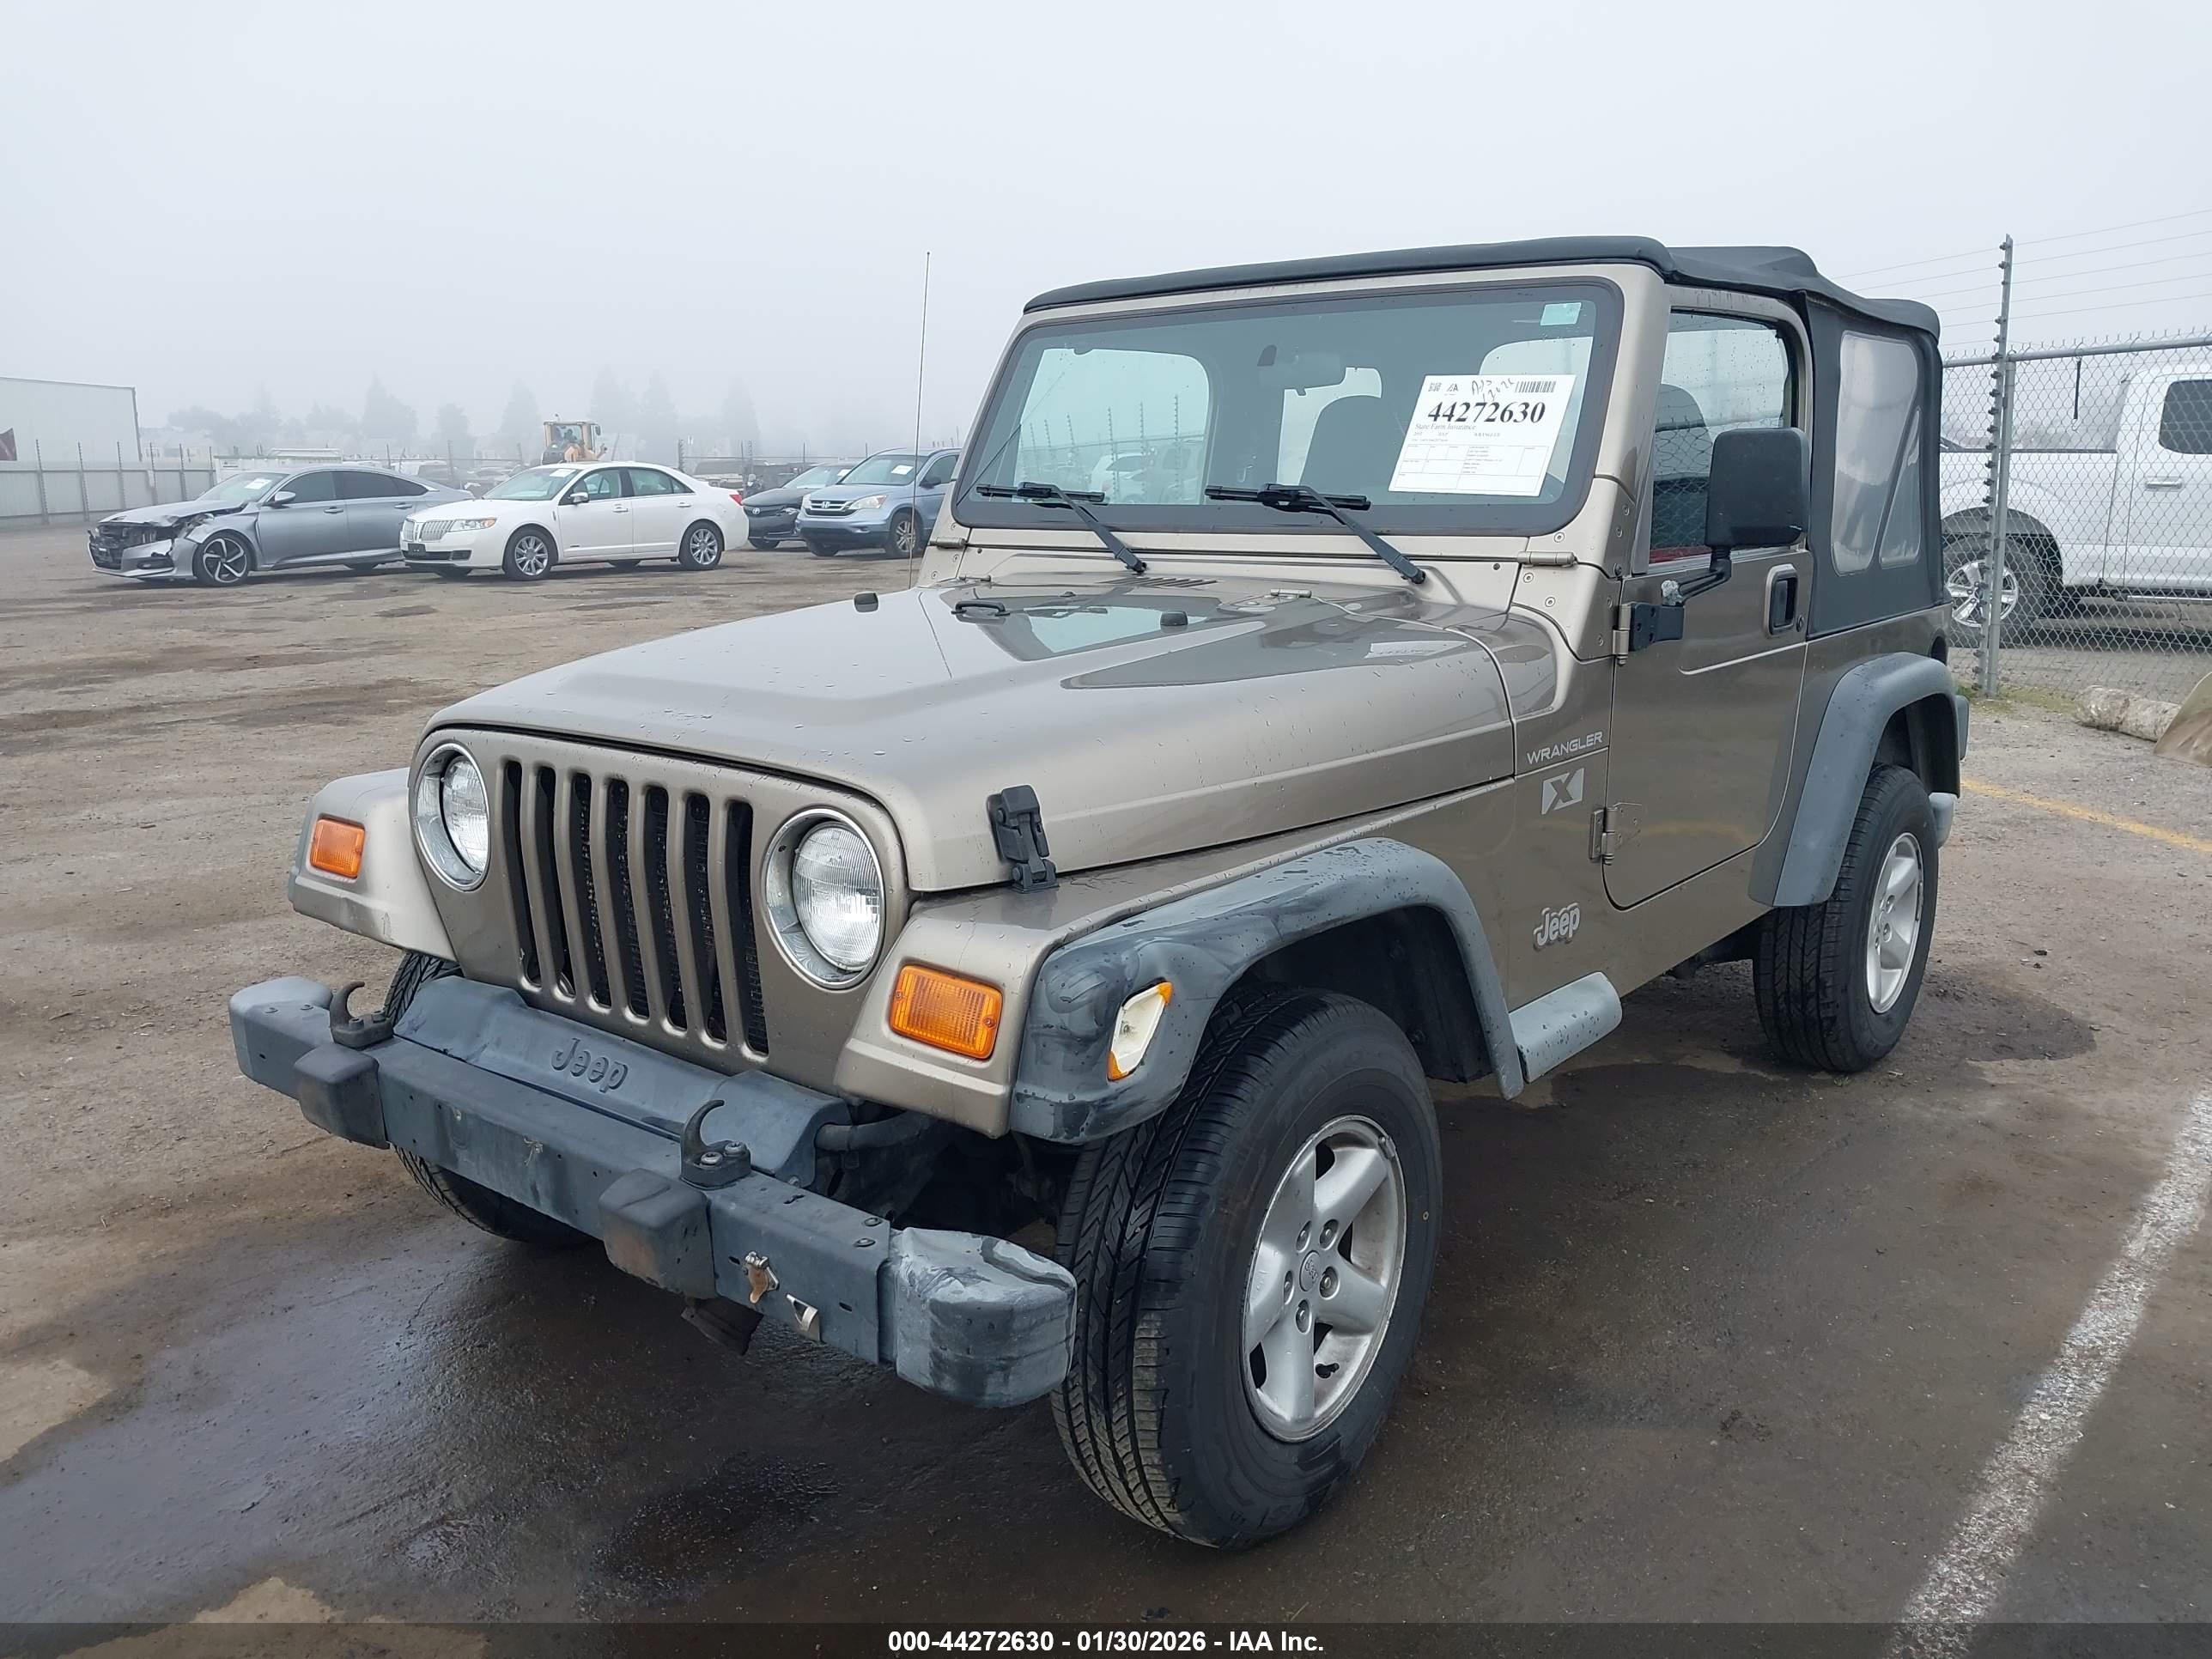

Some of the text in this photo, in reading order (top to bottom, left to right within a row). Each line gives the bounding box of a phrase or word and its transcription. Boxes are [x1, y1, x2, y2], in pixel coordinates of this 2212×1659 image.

[1427, 402, 1546, 423] 44272630
[1527, 732, 1602, 764] WRANGLER
[1534, 902, 1580, 946] Jeep
[551, 1037, 629, 1093] Jeep
